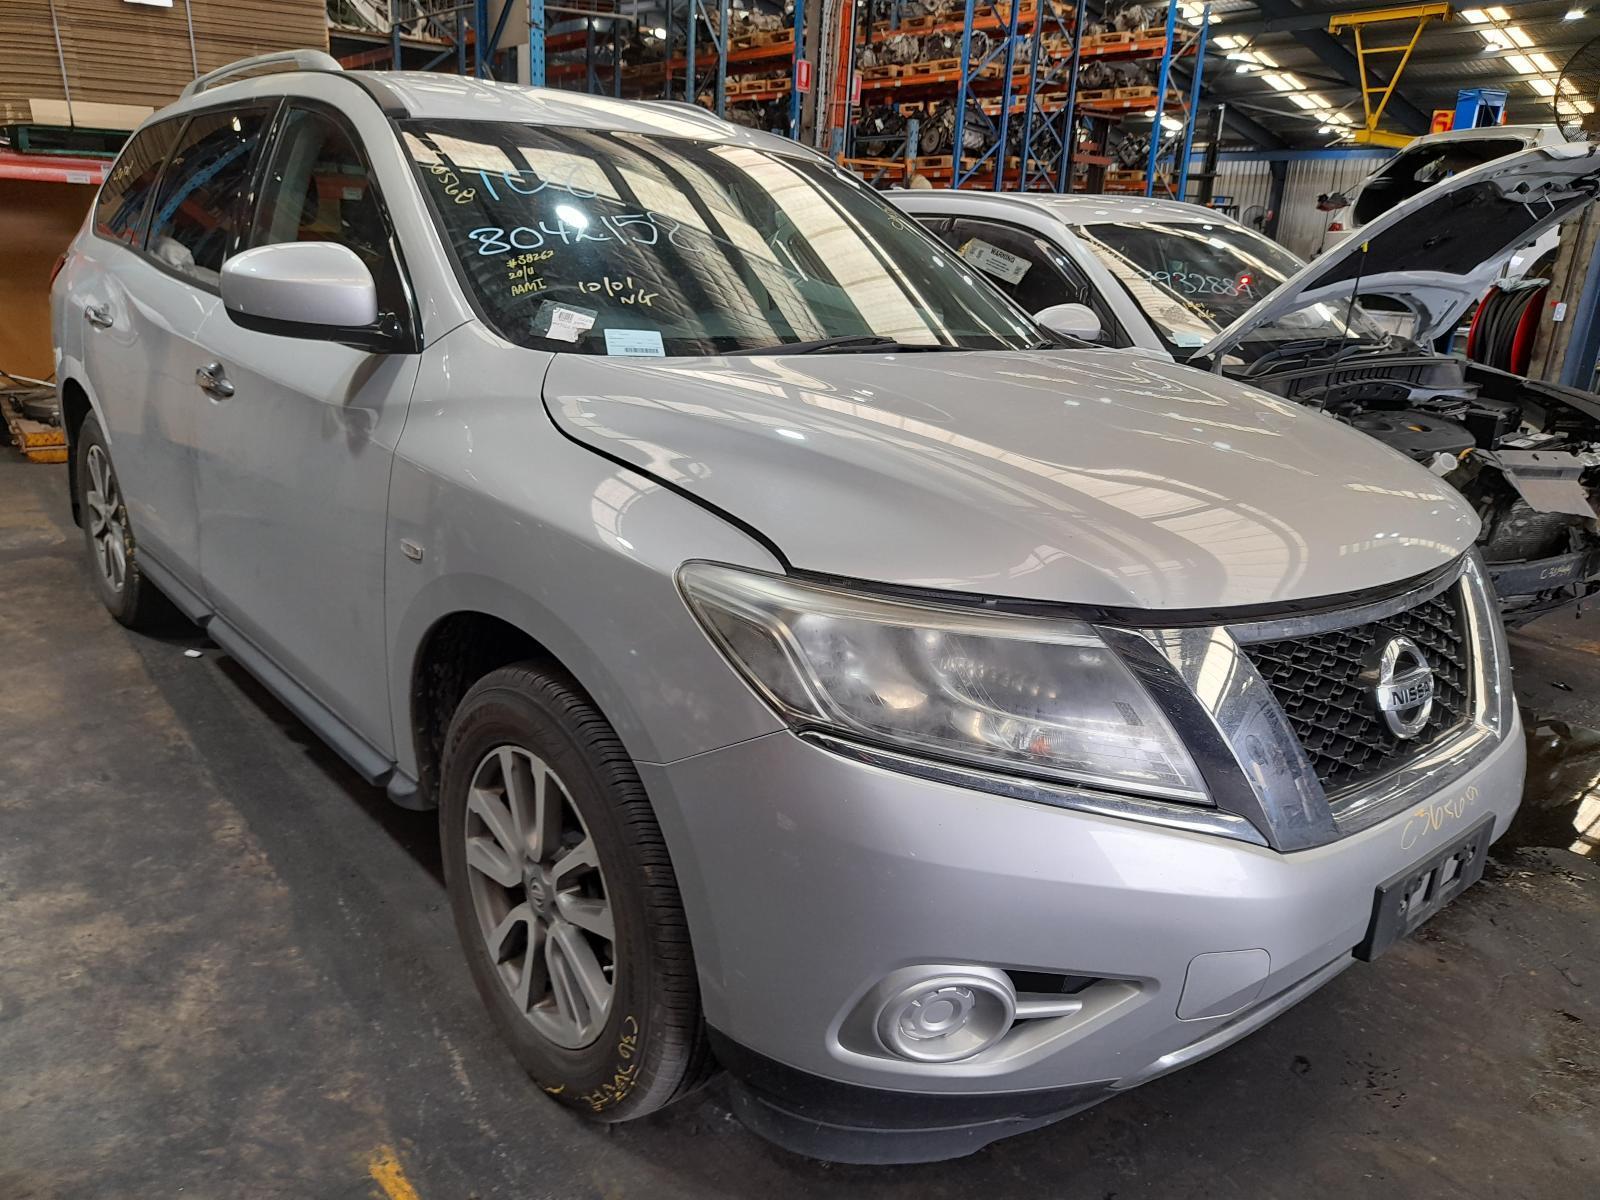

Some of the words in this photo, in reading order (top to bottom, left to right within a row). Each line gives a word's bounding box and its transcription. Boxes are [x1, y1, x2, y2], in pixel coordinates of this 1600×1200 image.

[990, 248, 1016, 263] WARNING
[511, 278, 547, 296] AAMI
[1391, 681, 1432, 706] NISSA
